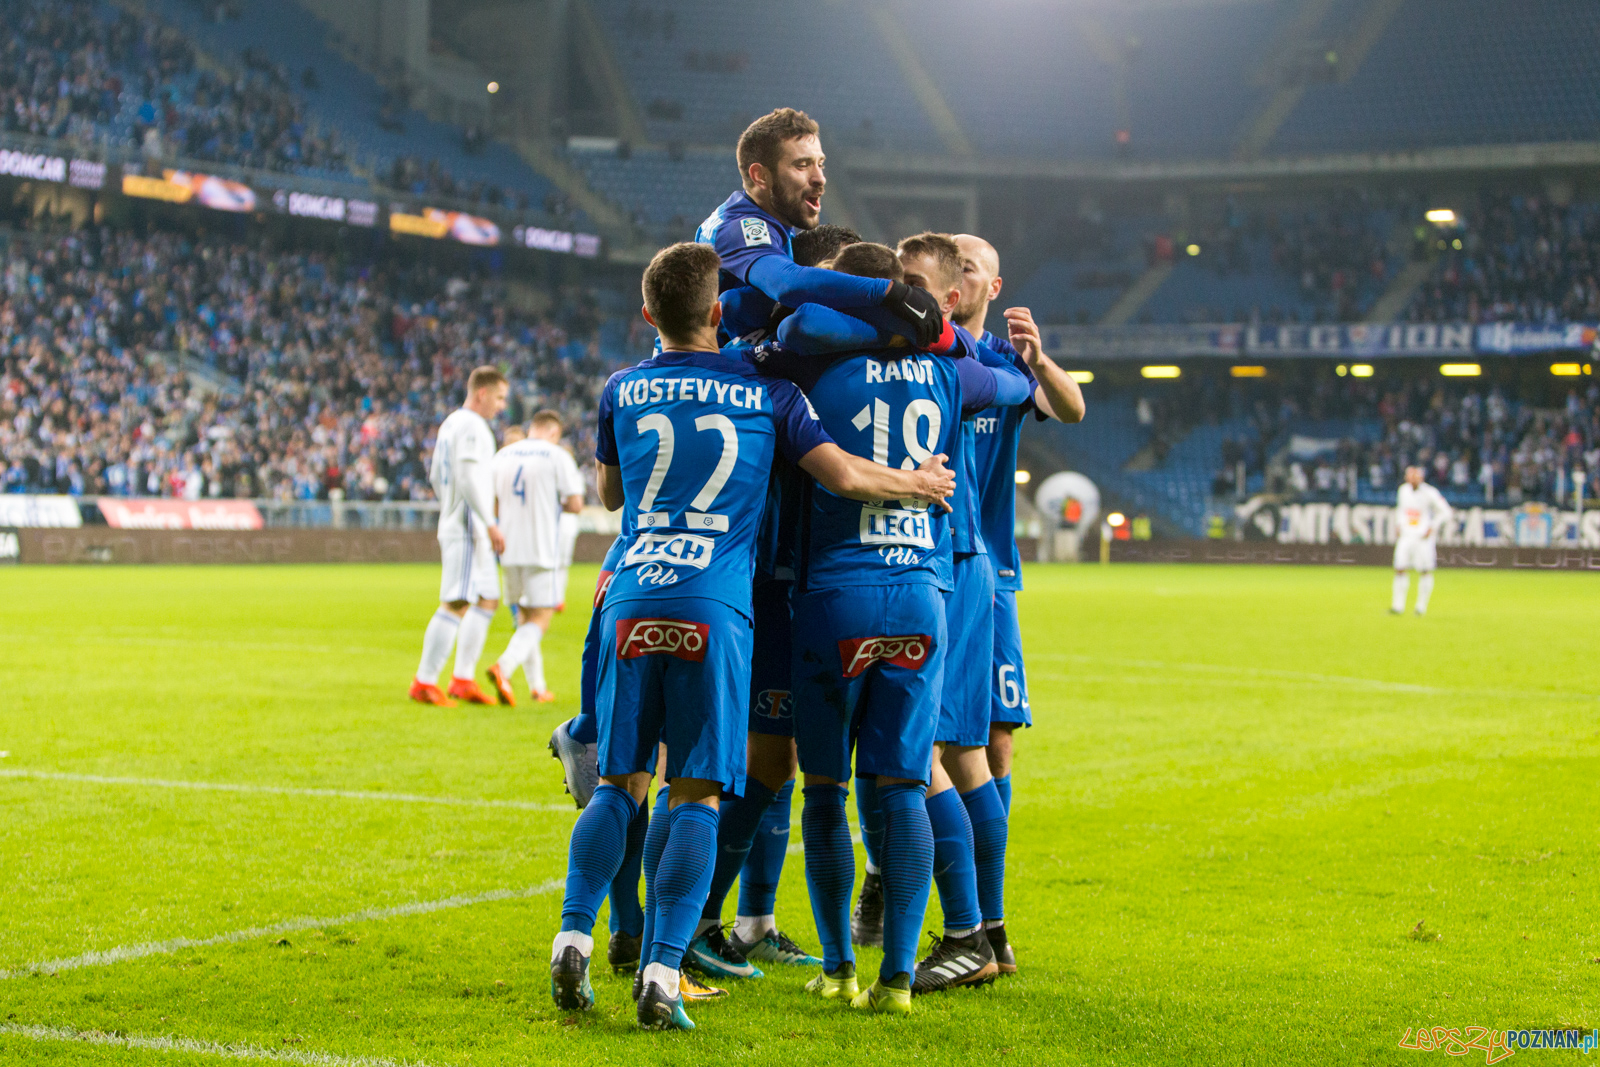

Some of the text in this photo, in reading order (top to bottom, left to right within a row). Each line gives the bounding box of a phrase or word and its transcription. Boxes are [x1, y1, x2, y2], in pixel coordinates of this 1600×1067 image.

[618, 377, 763, 410] KOSTEVYCH
[851, 396, 942, 512] 18
[513, 464, 525, 506] 4
[636, 413, 739, 533] 22
[867, 514, 926, 539] LECH
[879, 544, 923, 565] Pils
[637, 562, 679, 586] Pils
